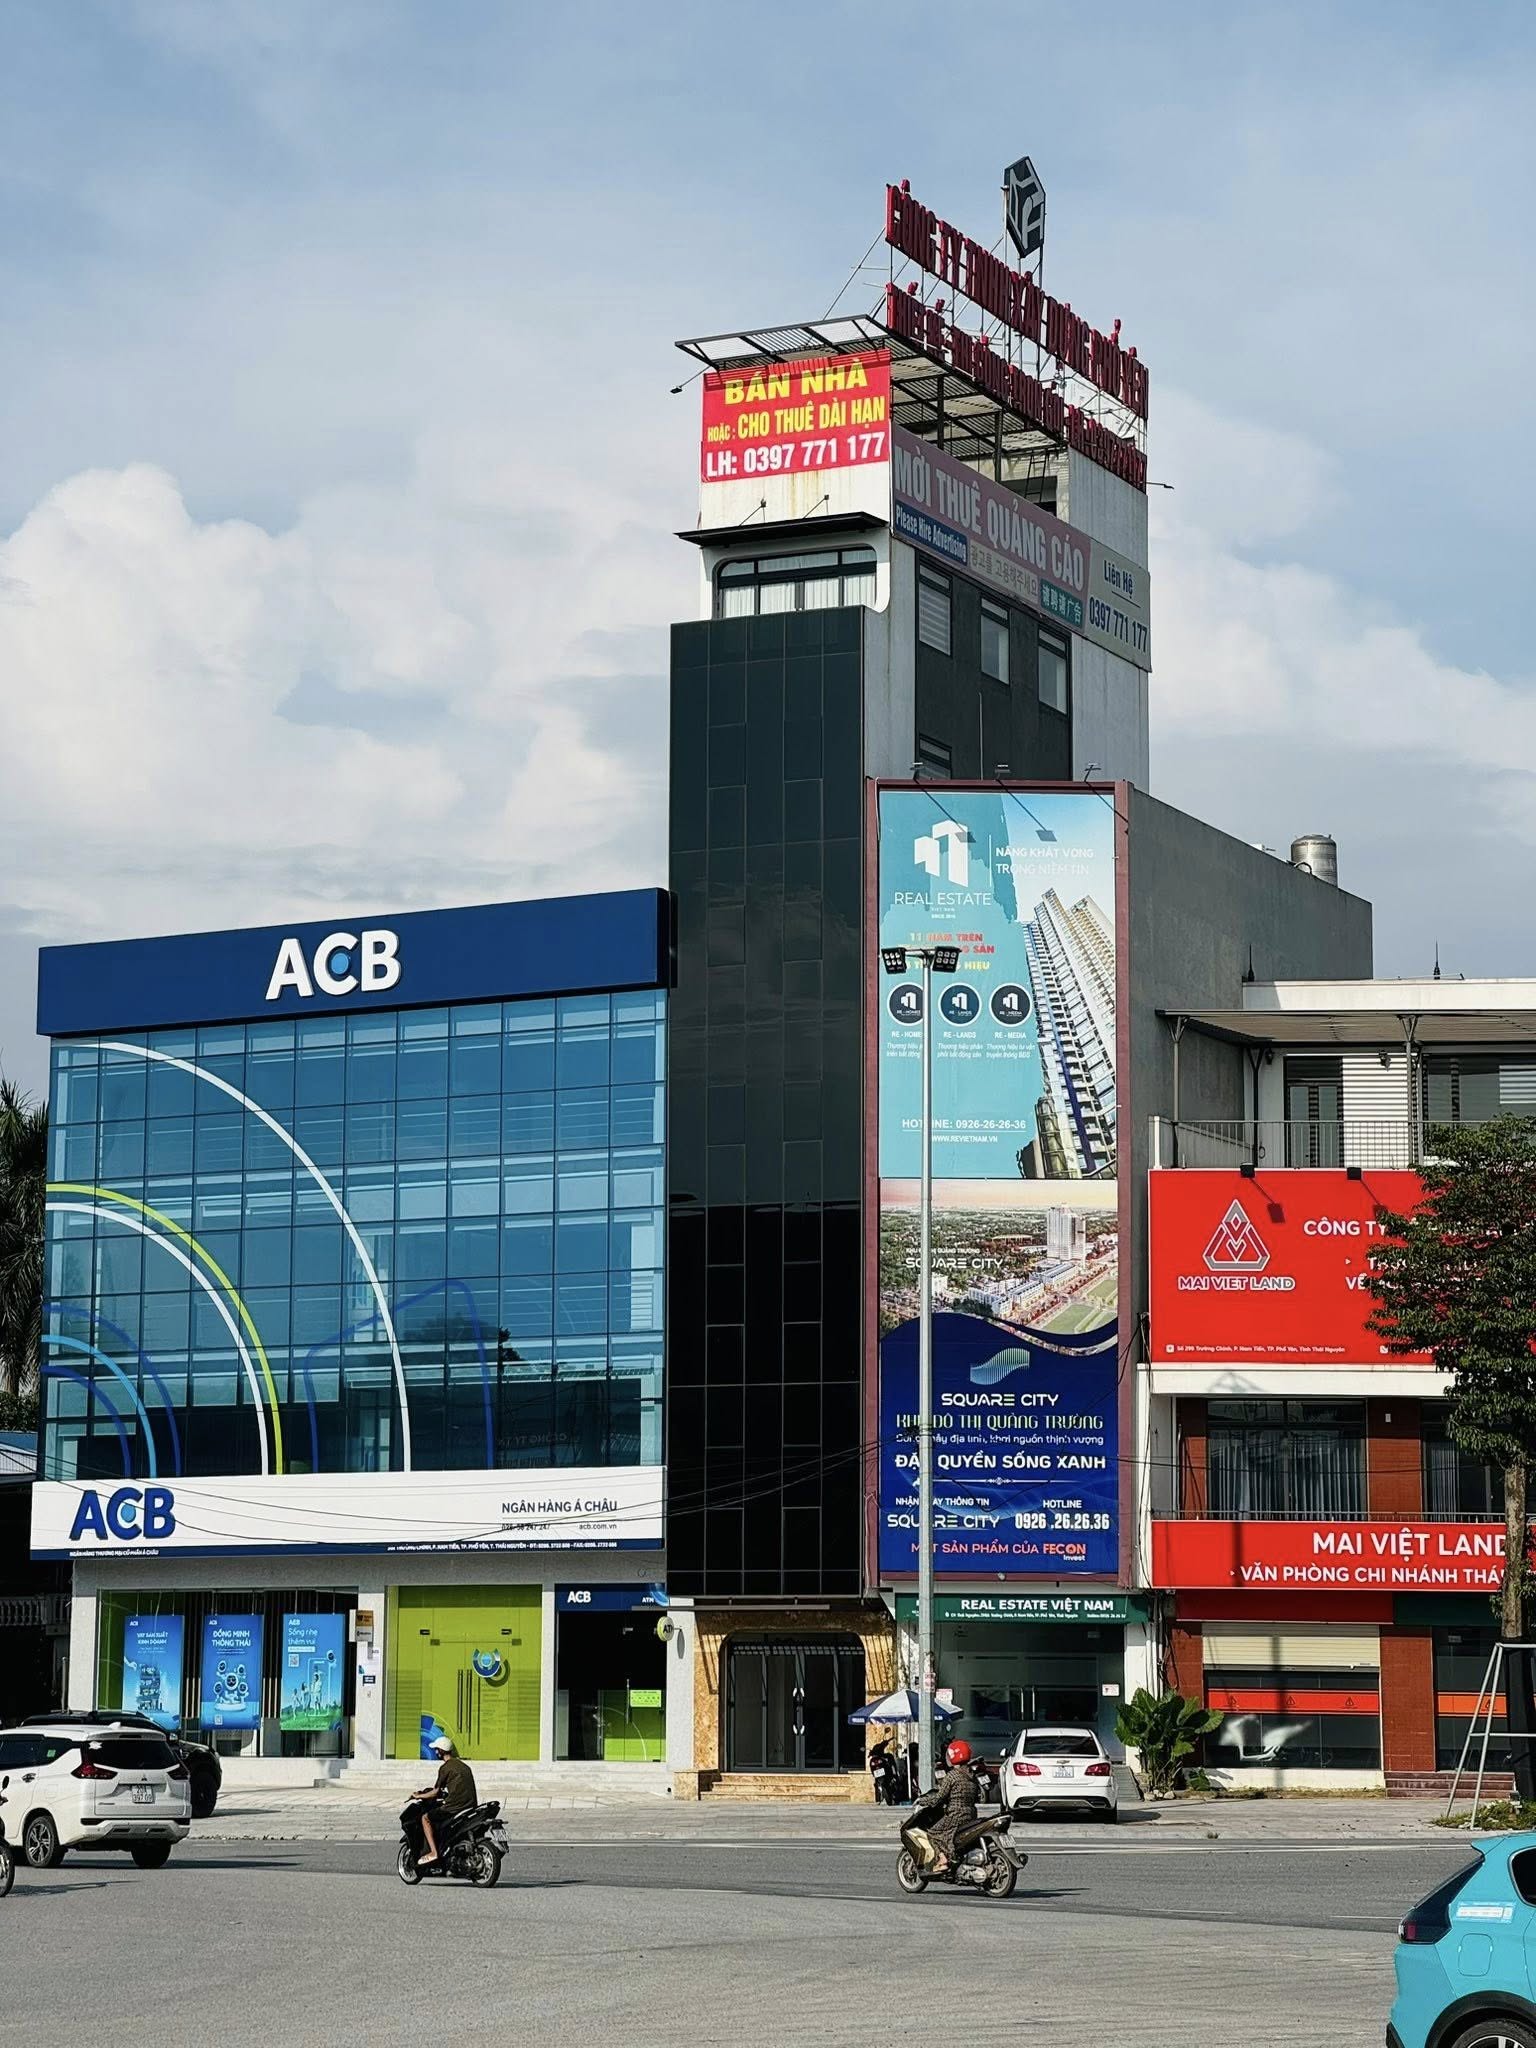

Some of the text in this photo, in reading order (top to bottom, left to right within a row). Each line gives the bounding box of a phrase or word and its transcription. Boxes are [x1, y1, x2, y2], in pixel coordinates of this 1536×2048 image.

[724, 359, 868, 405] BÁN NHÀ
[738, 411, 770, 439] CHO
[774, 400, 814, 434] THUÊ
[819, 396, 847, 429] DÀI
[851, 396, 886, 428] HẠN
[706, 432, 886, 477] LH: 0397 771 177
[893, 443, 1084, 592] MỜI THUÊ QUẢNG CÁO
[895, 505, 967, 563] Please Hire Advertising
[1103, 560, 1133, 599] Liên Hệ
[1089, 596, 1148, 654] 0397 771 177
[1030, 846, 1059, 857] KHÁT
[1061, 847, 1094, 858] VỌNG
[995, 863, 1035, 874] TRONG
[894, 892, 992, 906] REAL ESTATE
[265, 929, 402, 1000] ACB
[943, 1031, 977, 1039] RE LANDS
[902, 1119, 1027, 1129] HOTINE: 0926-26-26-36
[1303, 1217, 1361, 1236] CÔNG
[905, 1257, 1003, 1269] SARE CITY
[1178, 1275, 1296, 1291] MAI VIET LAND
[941, 1393, 1059, 1407] SQUARE CITY
[896, 1414, 920, 1428] KH
[958, 1414, 982, 1431] THỊ
[986, 1411, 1039, 1431] QUẢNG
[1044, 1411, 1104, 1430] TRƯỜNG
[1073, 1435, 1104, 1446] vượng
[894, 1450, 1106, 1470] ĐẶ QUYỀN SỐNG XANH
[501, 1497, 618, 1513] NGÂN HÀNG Á CHÂU
[895, 1496, 989, 1508] NHẬN THÔNG TIN
[1043, 1499, 1082, 1509] HOTLINE
[69, 1486, 176, 1541] ACB
[887, 1514, 1000, 1529] SQURE CITY
[911, 1538, 1086, 1554] MT SẢN PHẨM CỦA FECON
[1313, 1531, 1362, 1556] MAI
[1370, 1527, 1431, 1562] VIỆT
[1240, 1560, 1277, 1582] VĂN
[1282, 1561, 1349, 1583] PHÒNG
[1355, 1567, 1386, 1583] CHI
[1391, 1561, 1458, 1584] NHÁNH
[567, 1590, 592, 1603] ACB
[961, 1597, 1113, 1613] REAL ESTATE VIỆT NAM
[211, 1637, 251, 1647] THÔNG THÁI
[232, 1630, 250, 1638] MINH
